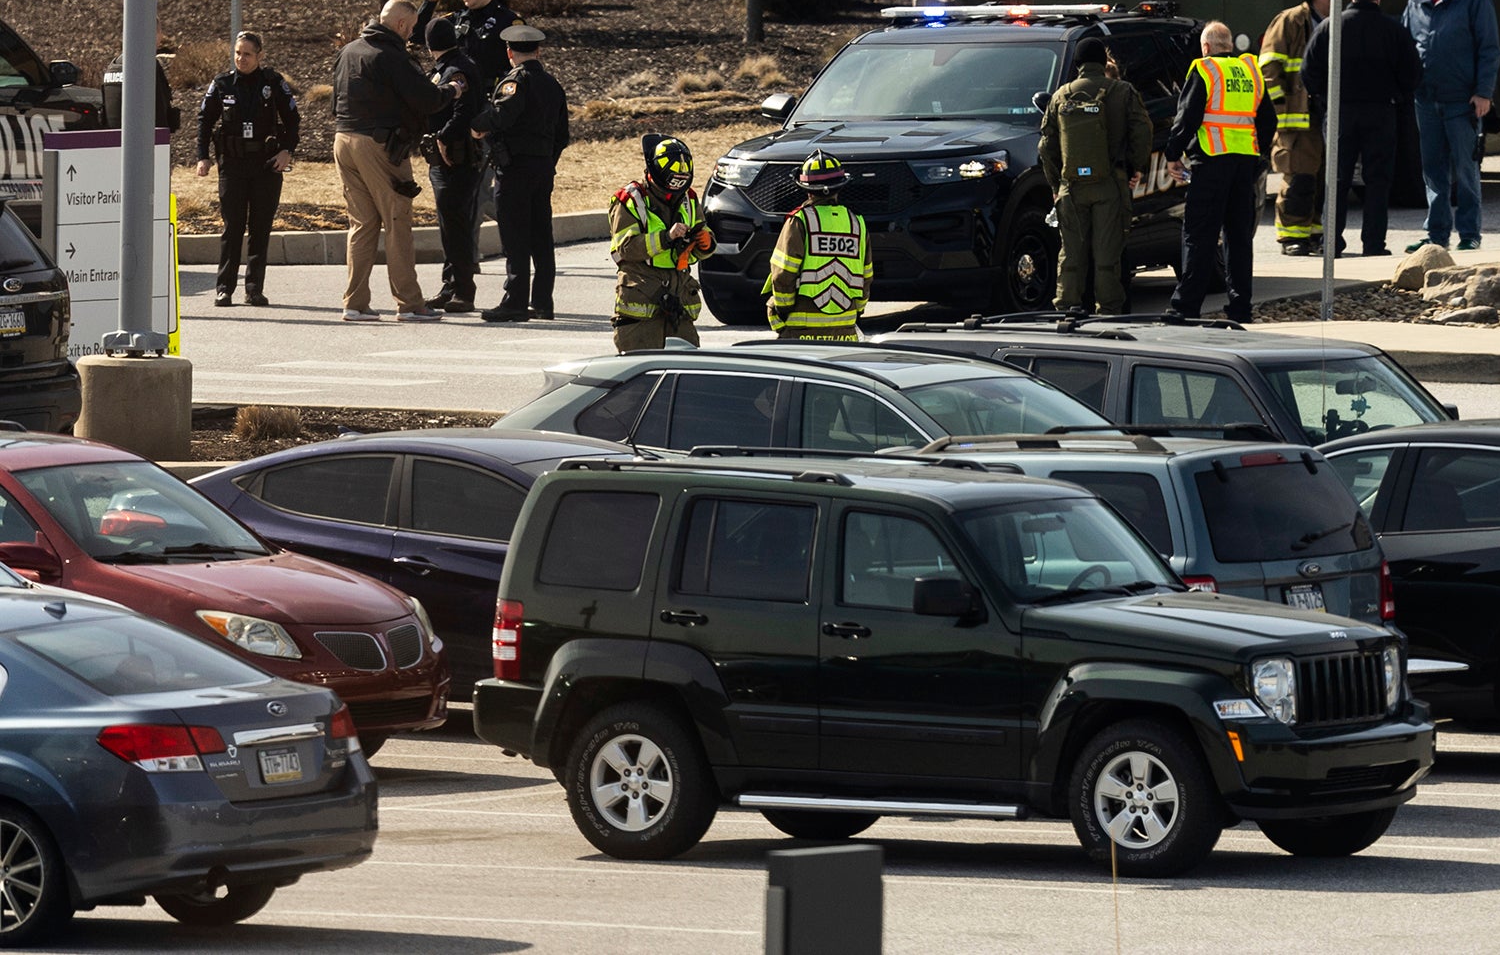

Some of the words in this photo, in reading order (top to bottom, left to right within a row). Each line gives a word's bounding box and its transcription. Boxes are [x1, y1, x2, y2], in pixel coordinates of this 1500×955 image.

[1226, 78, 1241, 93] EMS
[669, 178, 687, 188] 50
[66, 192, 95, 206] Visitor
[817, 237, 855, 253] E502
[66, 270, 88, 284] Main
[90, 268, 119, 283] Entran
[83, 343, 92, 356] to
